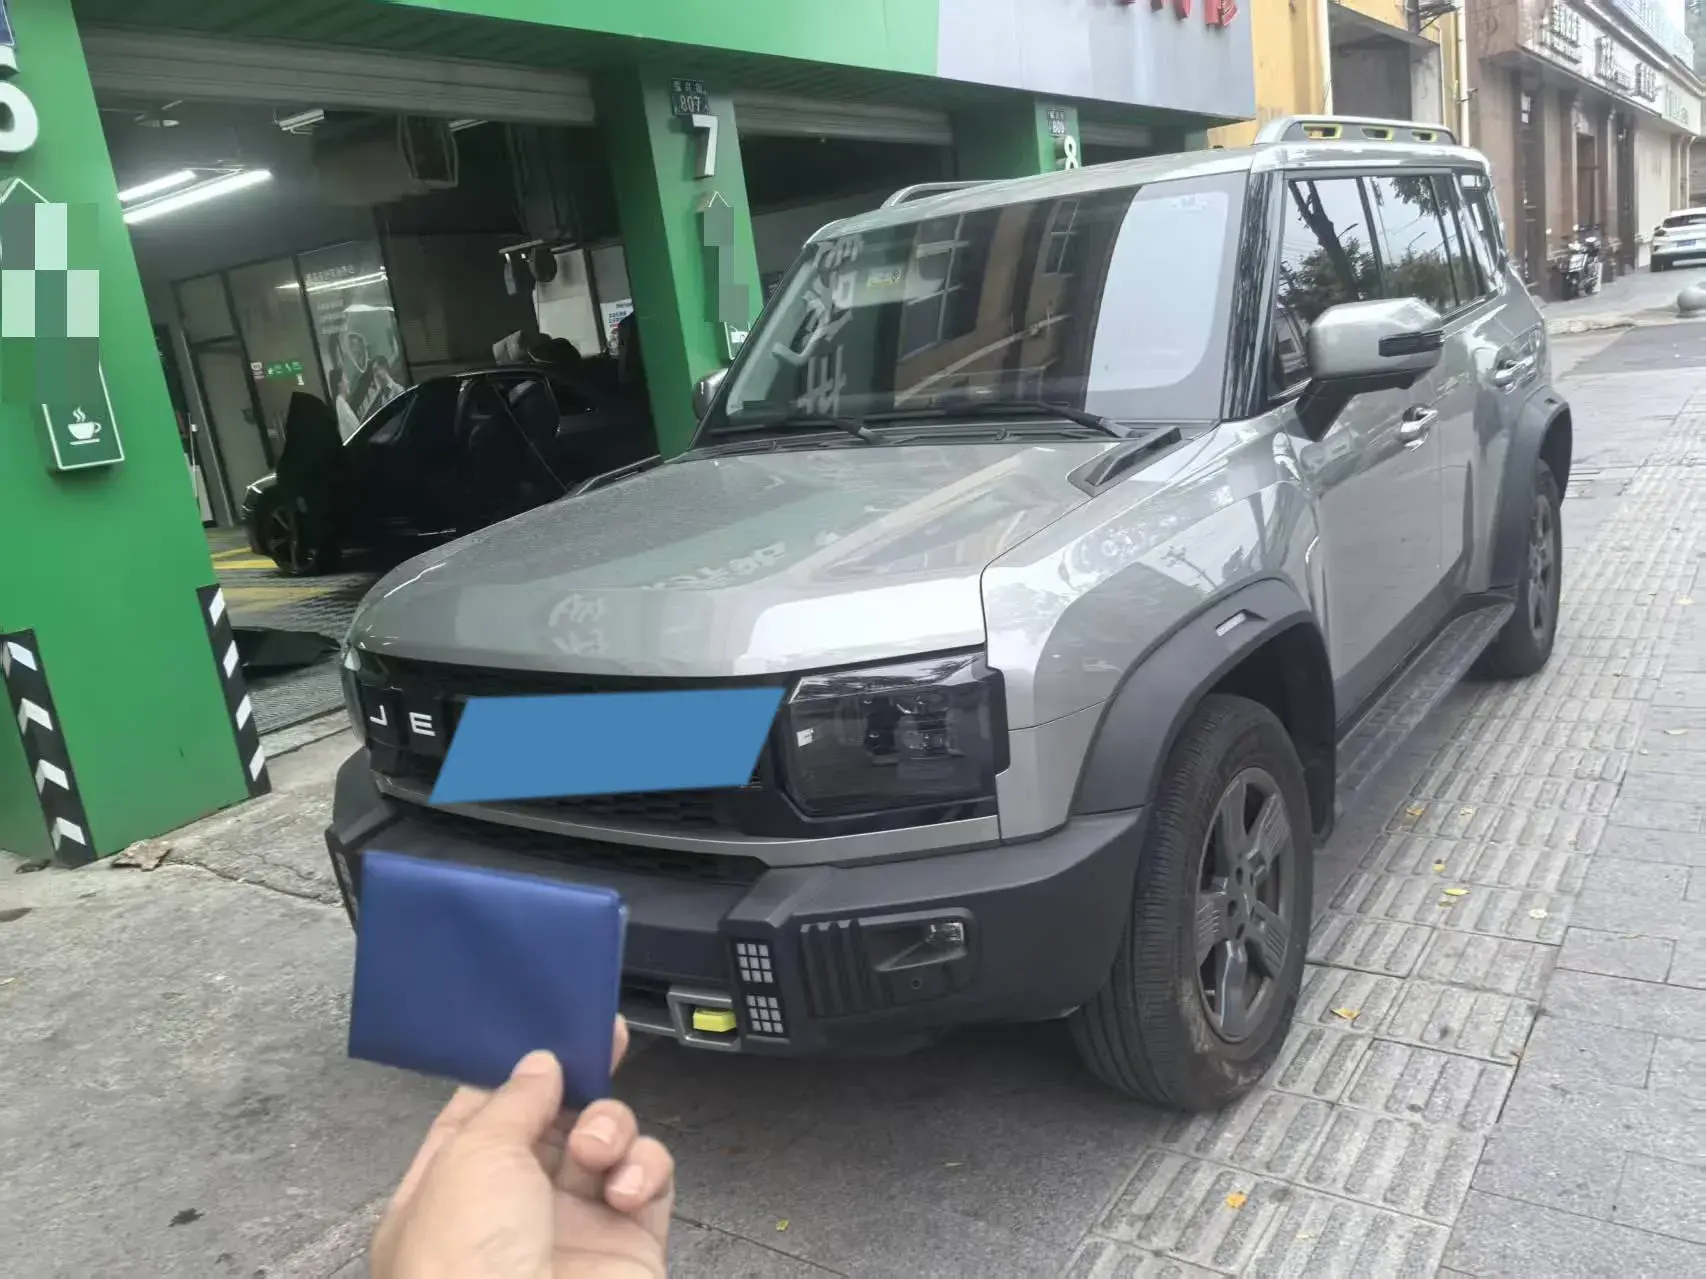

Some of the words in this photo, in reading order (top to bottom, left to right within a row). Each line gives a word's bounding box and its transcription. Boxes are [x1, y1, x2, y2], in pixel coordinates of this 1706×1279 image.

[680, 95, 701, 113] 807
[692, 114, 718, 176] 7
[1064, 135, 1079, 171] 8
